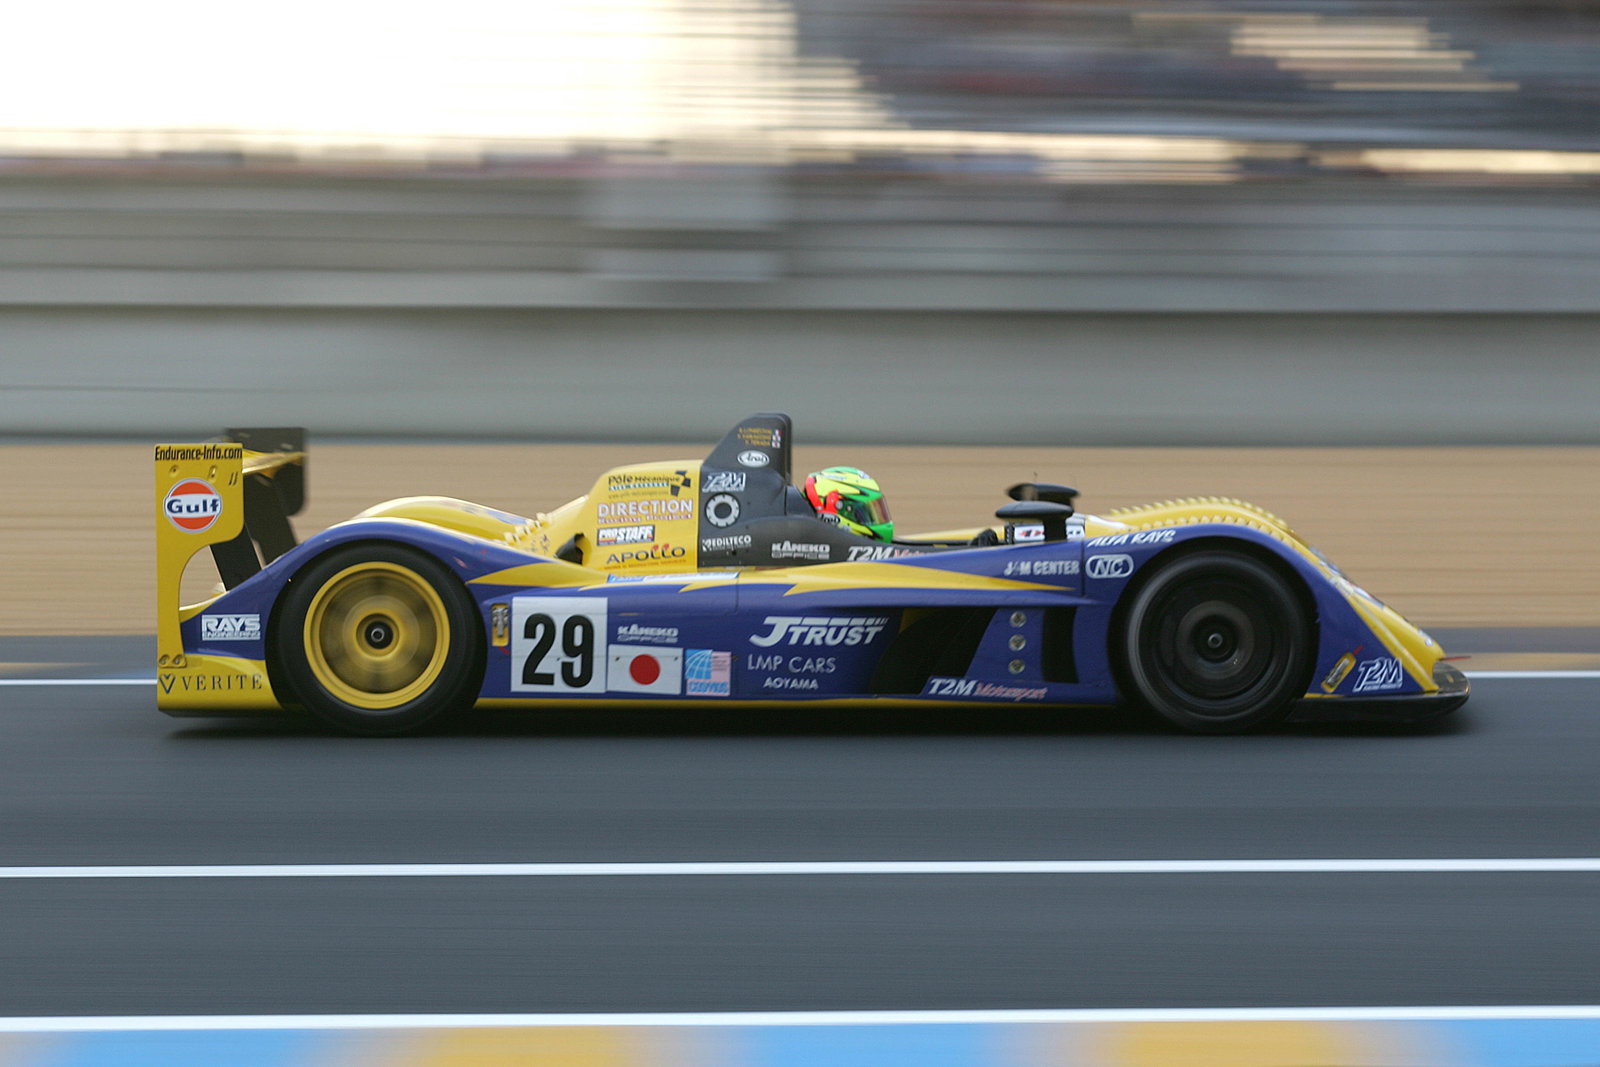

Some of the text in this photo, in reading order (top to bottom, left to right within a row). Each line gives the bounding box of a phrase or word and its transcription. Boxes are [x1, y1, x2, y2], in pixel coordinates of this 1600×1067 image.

[154, 445, 243, 461] Endurance-Info.com
[167, 498, 220, 514] Gulf
[598, 499, 693, 517] DIRECTION
[1130, 530, 1177, 544] RAYS
[606, 544, 687, 564] APOLLO
[846, 546, 893, 561] T2M
[1033, 560, 1081, 576] CENTER
[202, 615, 261, 632] RAYS
[522, 612, 595, 688] 29
[747, 653, 783, 671] LMP
[788, 656, 837, 673] CARS
[763, 676, 819, 690] AOYAMA
[1352, 657, 1403, 692] T2M
[928, 678, 979, 696] T2M
